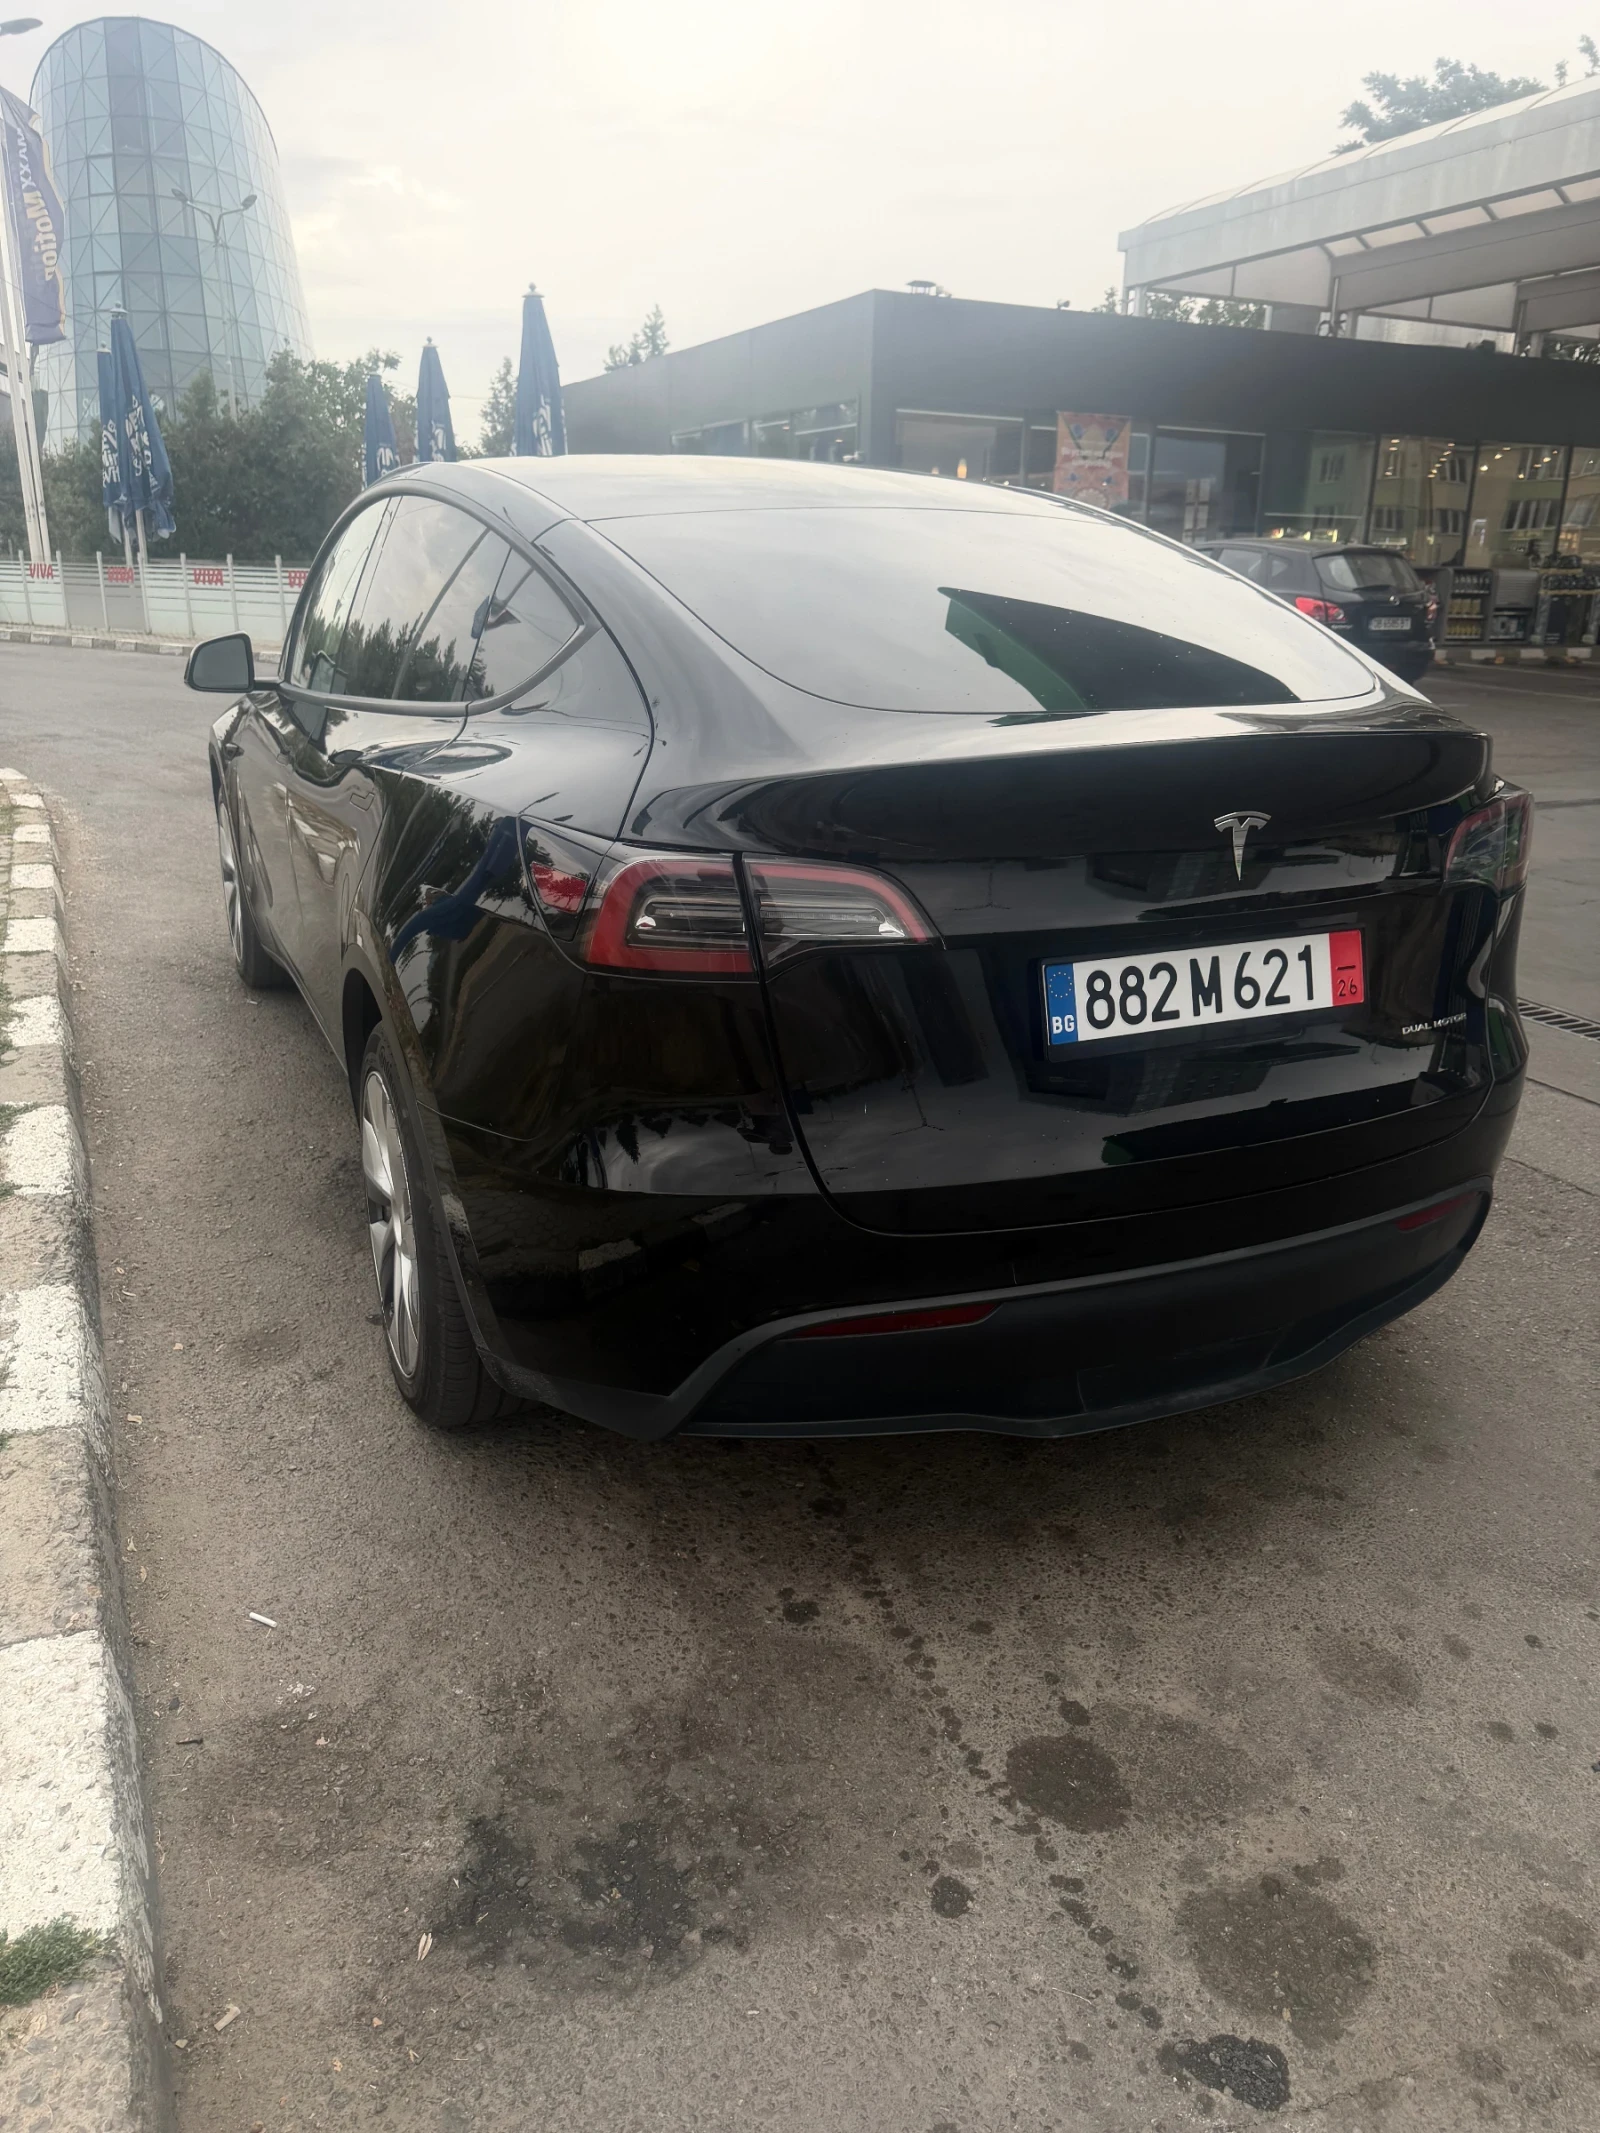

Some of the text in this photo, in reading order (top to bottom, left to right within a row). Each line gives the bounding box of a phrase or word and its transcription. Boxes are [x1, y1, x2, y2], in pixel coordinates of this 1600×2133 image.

[29, 562, 54, 580] VIVA
[1052, 1015, 1075, 1035] BG
[1337, 976, 1358, 997] 26
[1402, 1012, 1467, 1035] DUAL MOTOR
